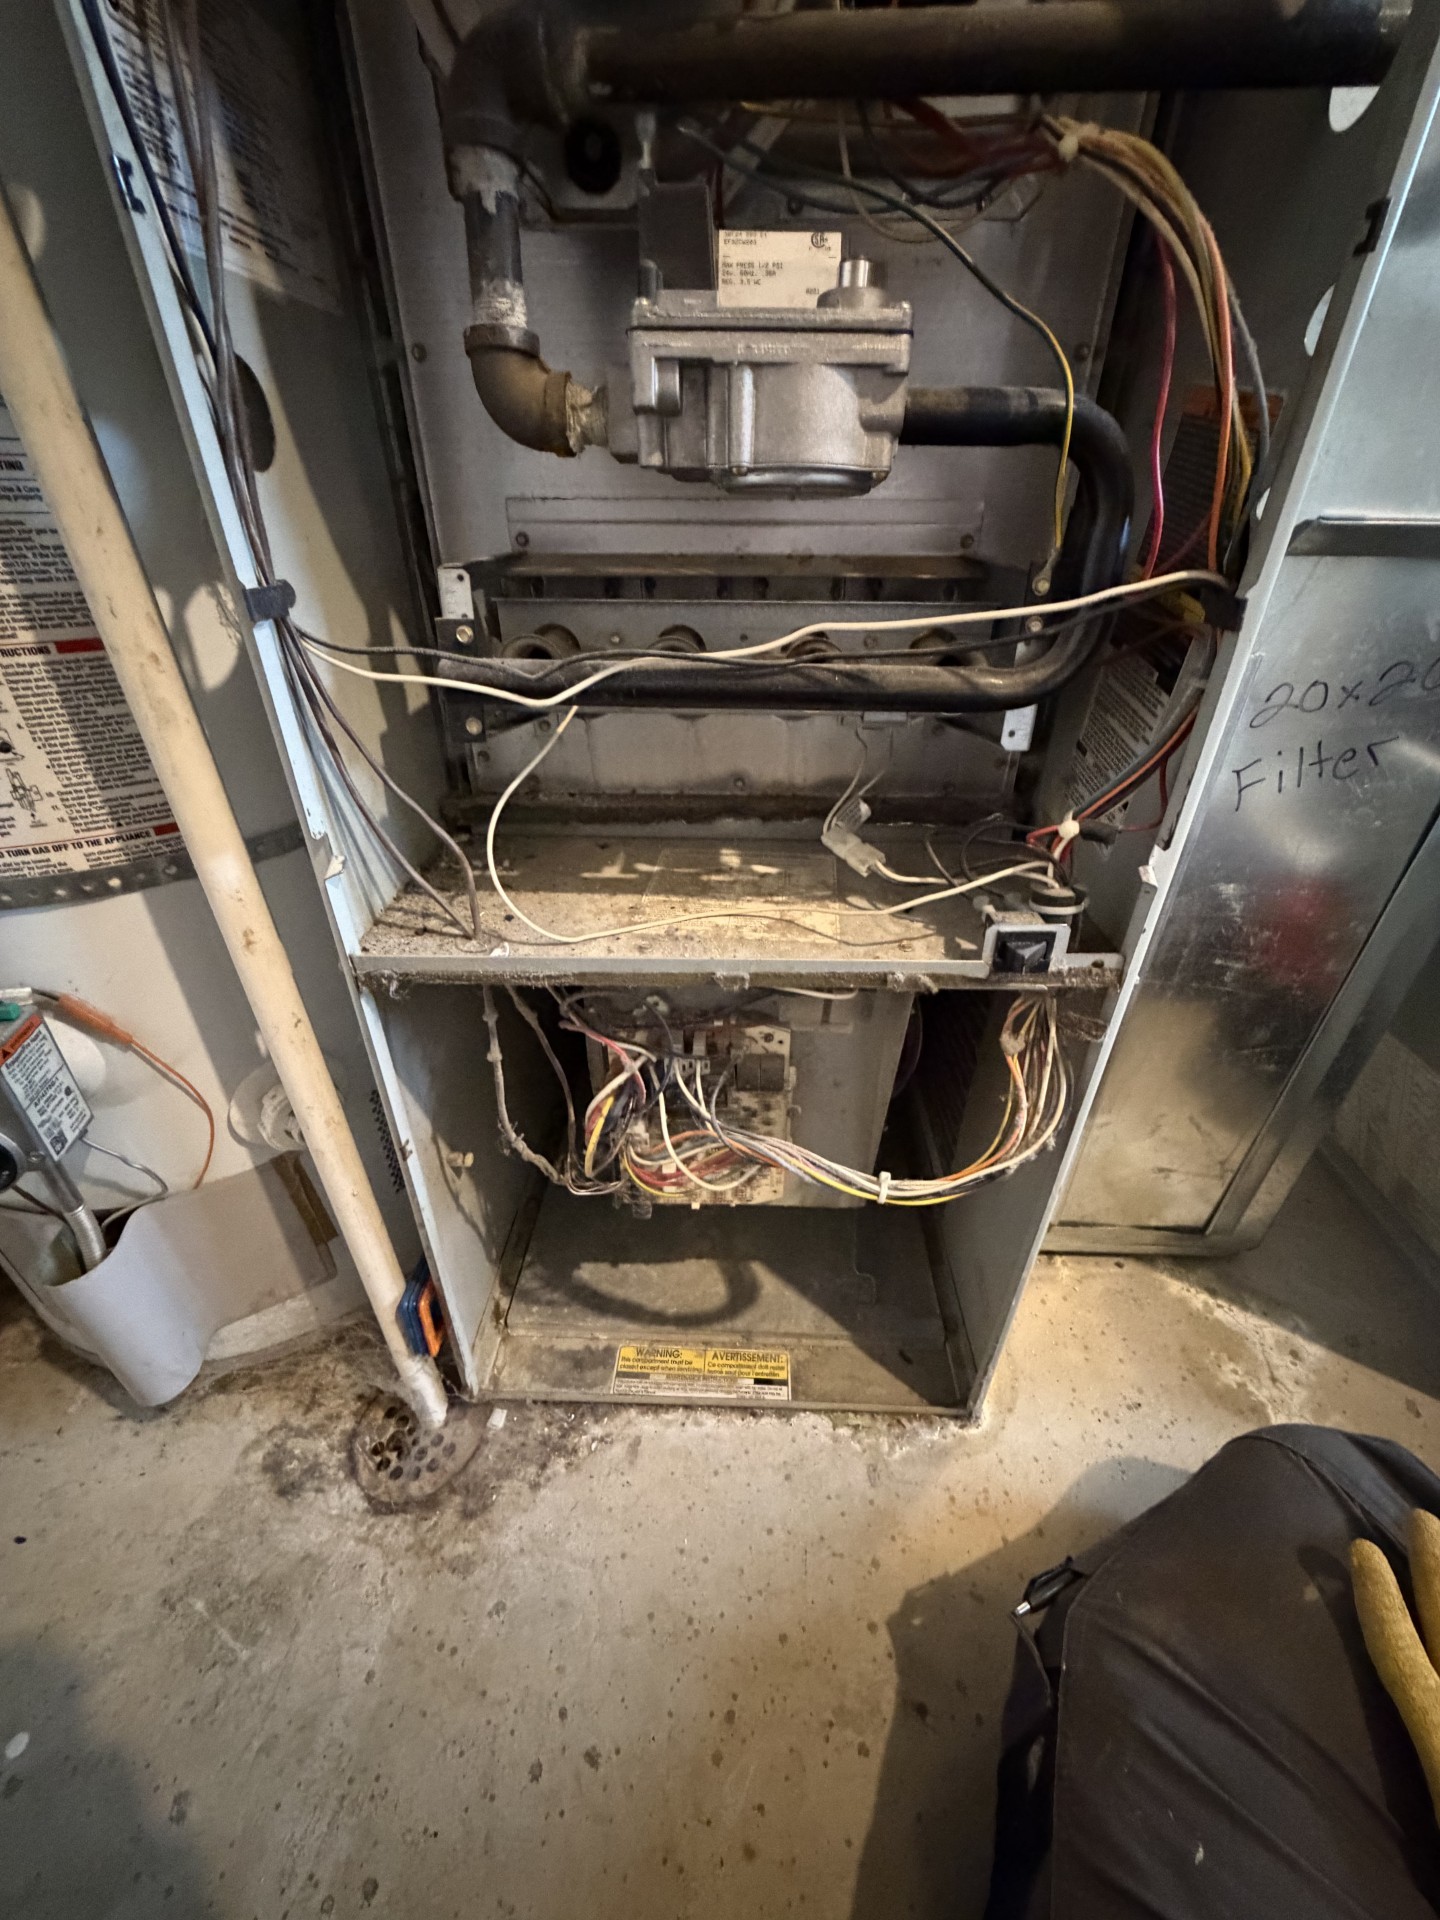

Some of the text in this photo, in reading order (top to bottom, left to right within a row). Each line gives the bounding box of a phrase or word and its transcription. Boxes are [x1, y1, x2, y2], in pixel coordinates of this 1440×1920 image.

[1232, 736, 1400, 812] Filter
[5, 848, 31, 858] TURN
[31, 845, 51, 855] GAS
[51, 842, 69, 852] OFF
[70, 841, 84, 850] TO
[83, 838, 102, 848] THE
[103, 829, 152, 845] APPLIANCE
[711, 1351, 785, 1364] AVERTISSEMENT:
